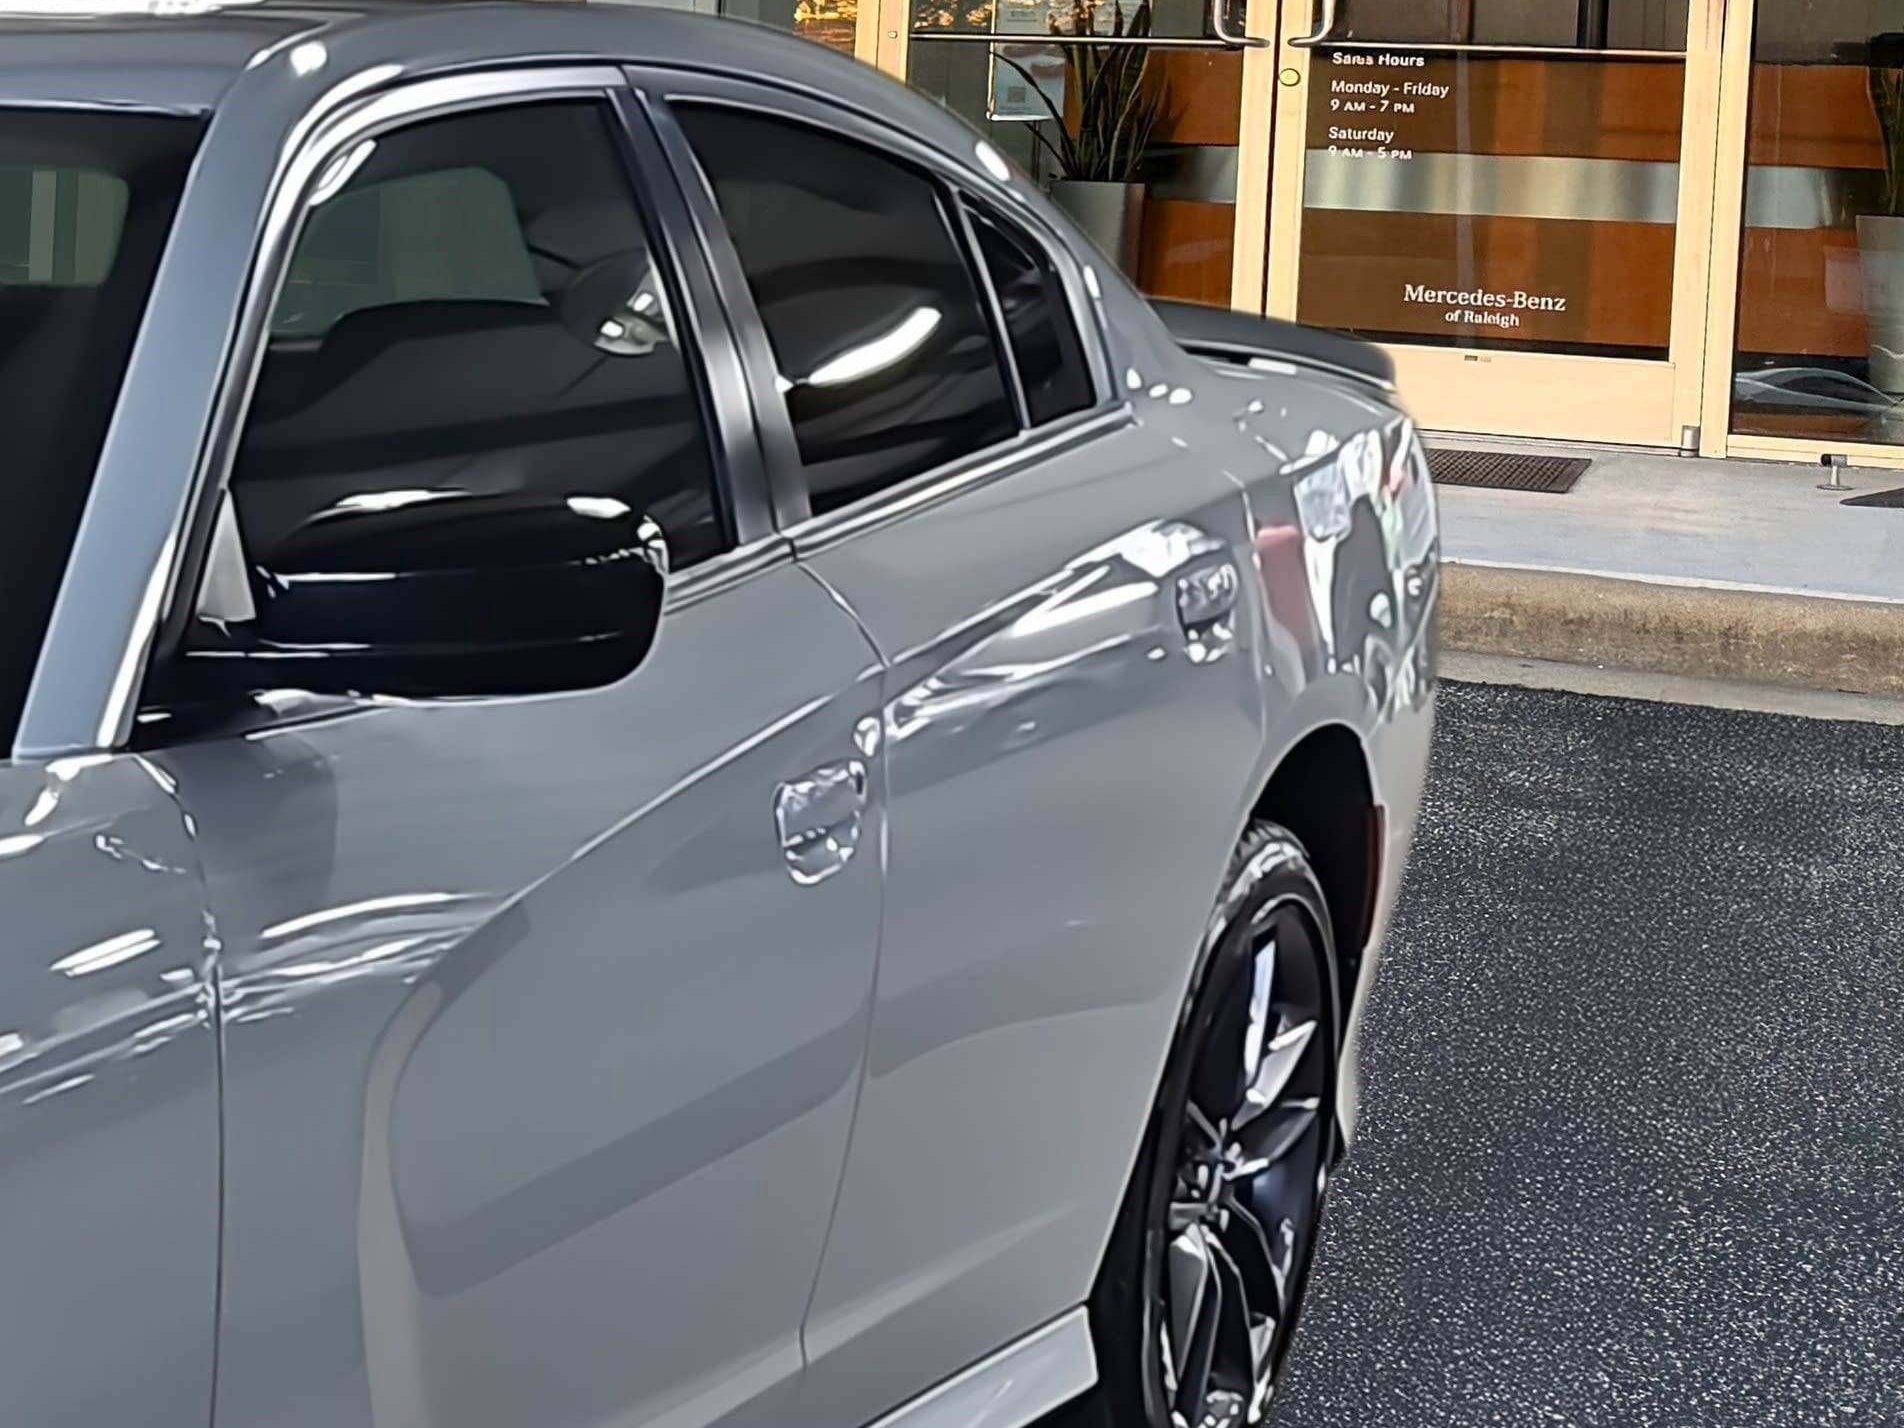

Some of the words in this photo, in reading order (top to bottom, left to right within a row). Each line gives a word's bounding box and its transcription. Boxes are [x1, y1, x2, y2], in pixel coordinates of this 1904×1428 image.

[1378, 53, 1425, 67] Hours
[1331, 80, 1390, 97] Monday
[1403, 82, 1449, 98] Friday
[1330, 98, 1340, 111] 9
[1344, 101, 1365, 112] AM
[1380, 100, 1389, 112] 7
[1393, 103, 1415, 113] PM
[1328, 126, 1394, 143] Saturday
[1328, 145, 1337, 157] 9
[1377, 147, 1386, 159] 5
[1392, 149, 1412, 160] PM
[1404, 284, 1566, 311] Mercedes-Benz
[1445, 310, 1461, 322] of
